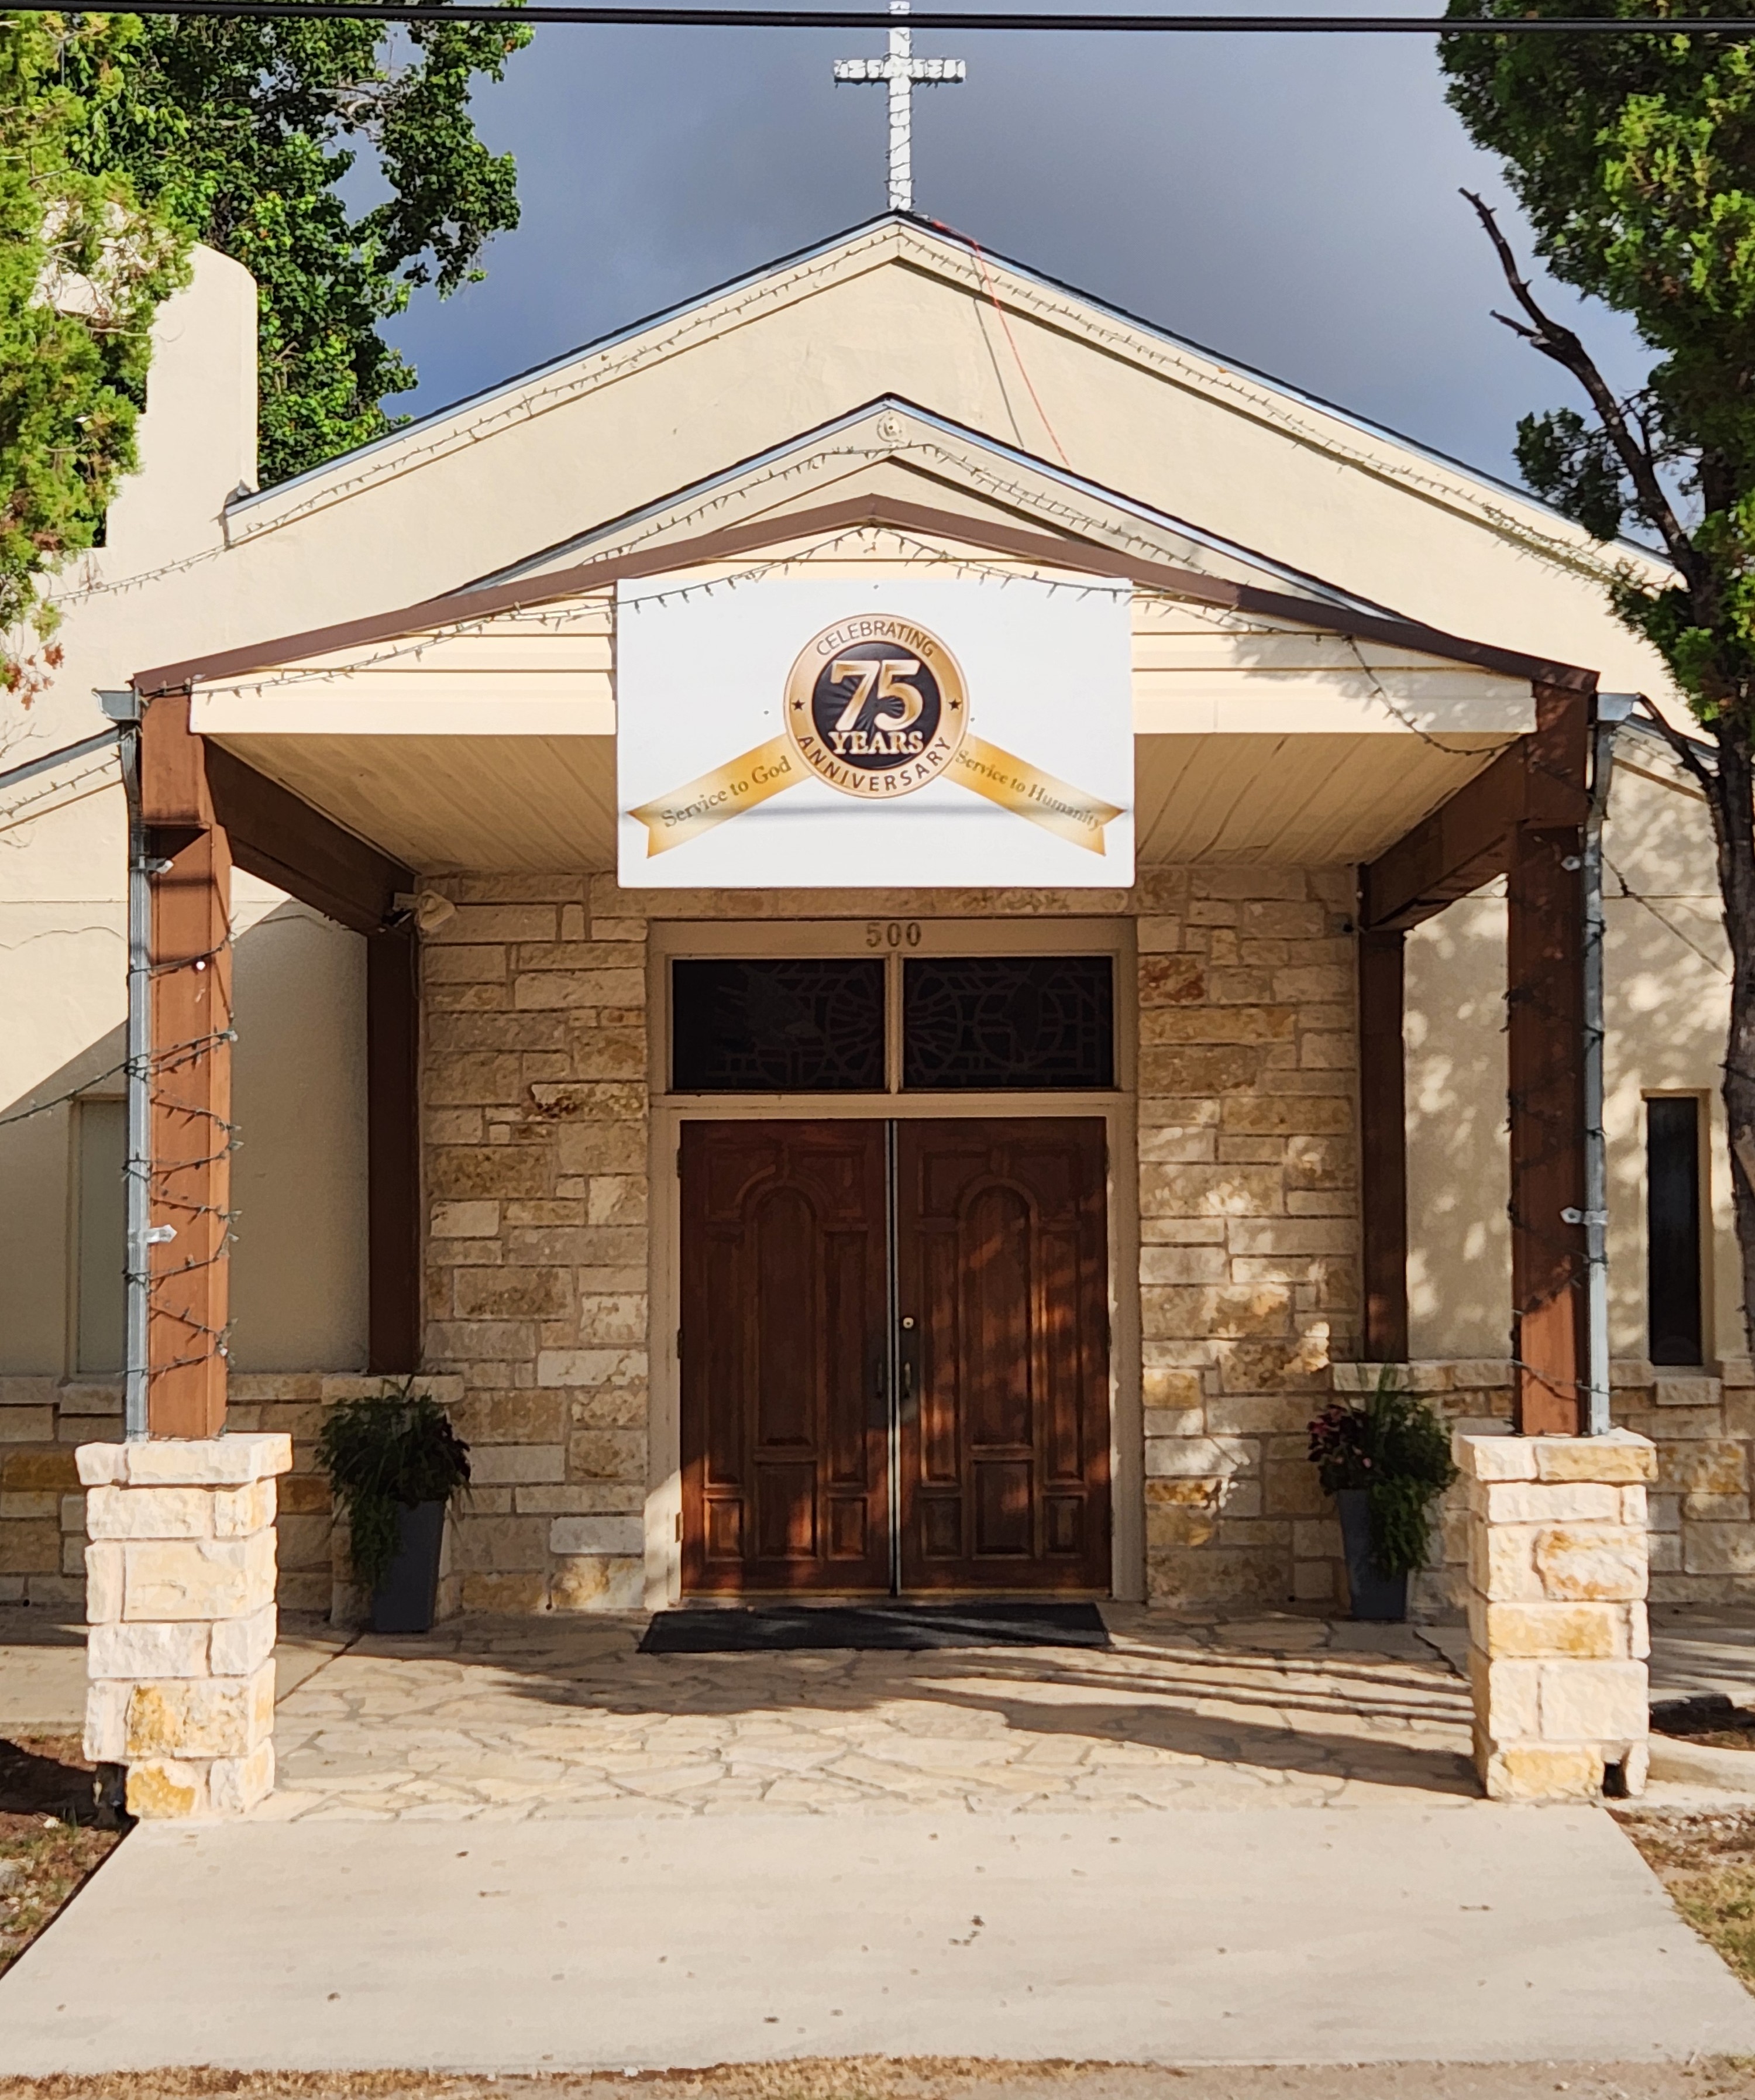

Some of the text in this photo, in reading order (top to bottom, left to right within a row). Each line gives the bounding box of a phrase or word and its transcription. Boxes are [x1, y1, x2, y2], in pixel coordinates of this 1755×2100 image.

[817, 620, 937, 657] CELEBRATING
[830, 659, 923, 731] 75
[797, 736, 951, 792] ANNIVERSARY
[828, 731, 923, 754] YEARS
[662, 755, 792, 827] Service to God
[955, 749, 1103, 831] Service to Humanity
[866, 922, 921, 948] 500
